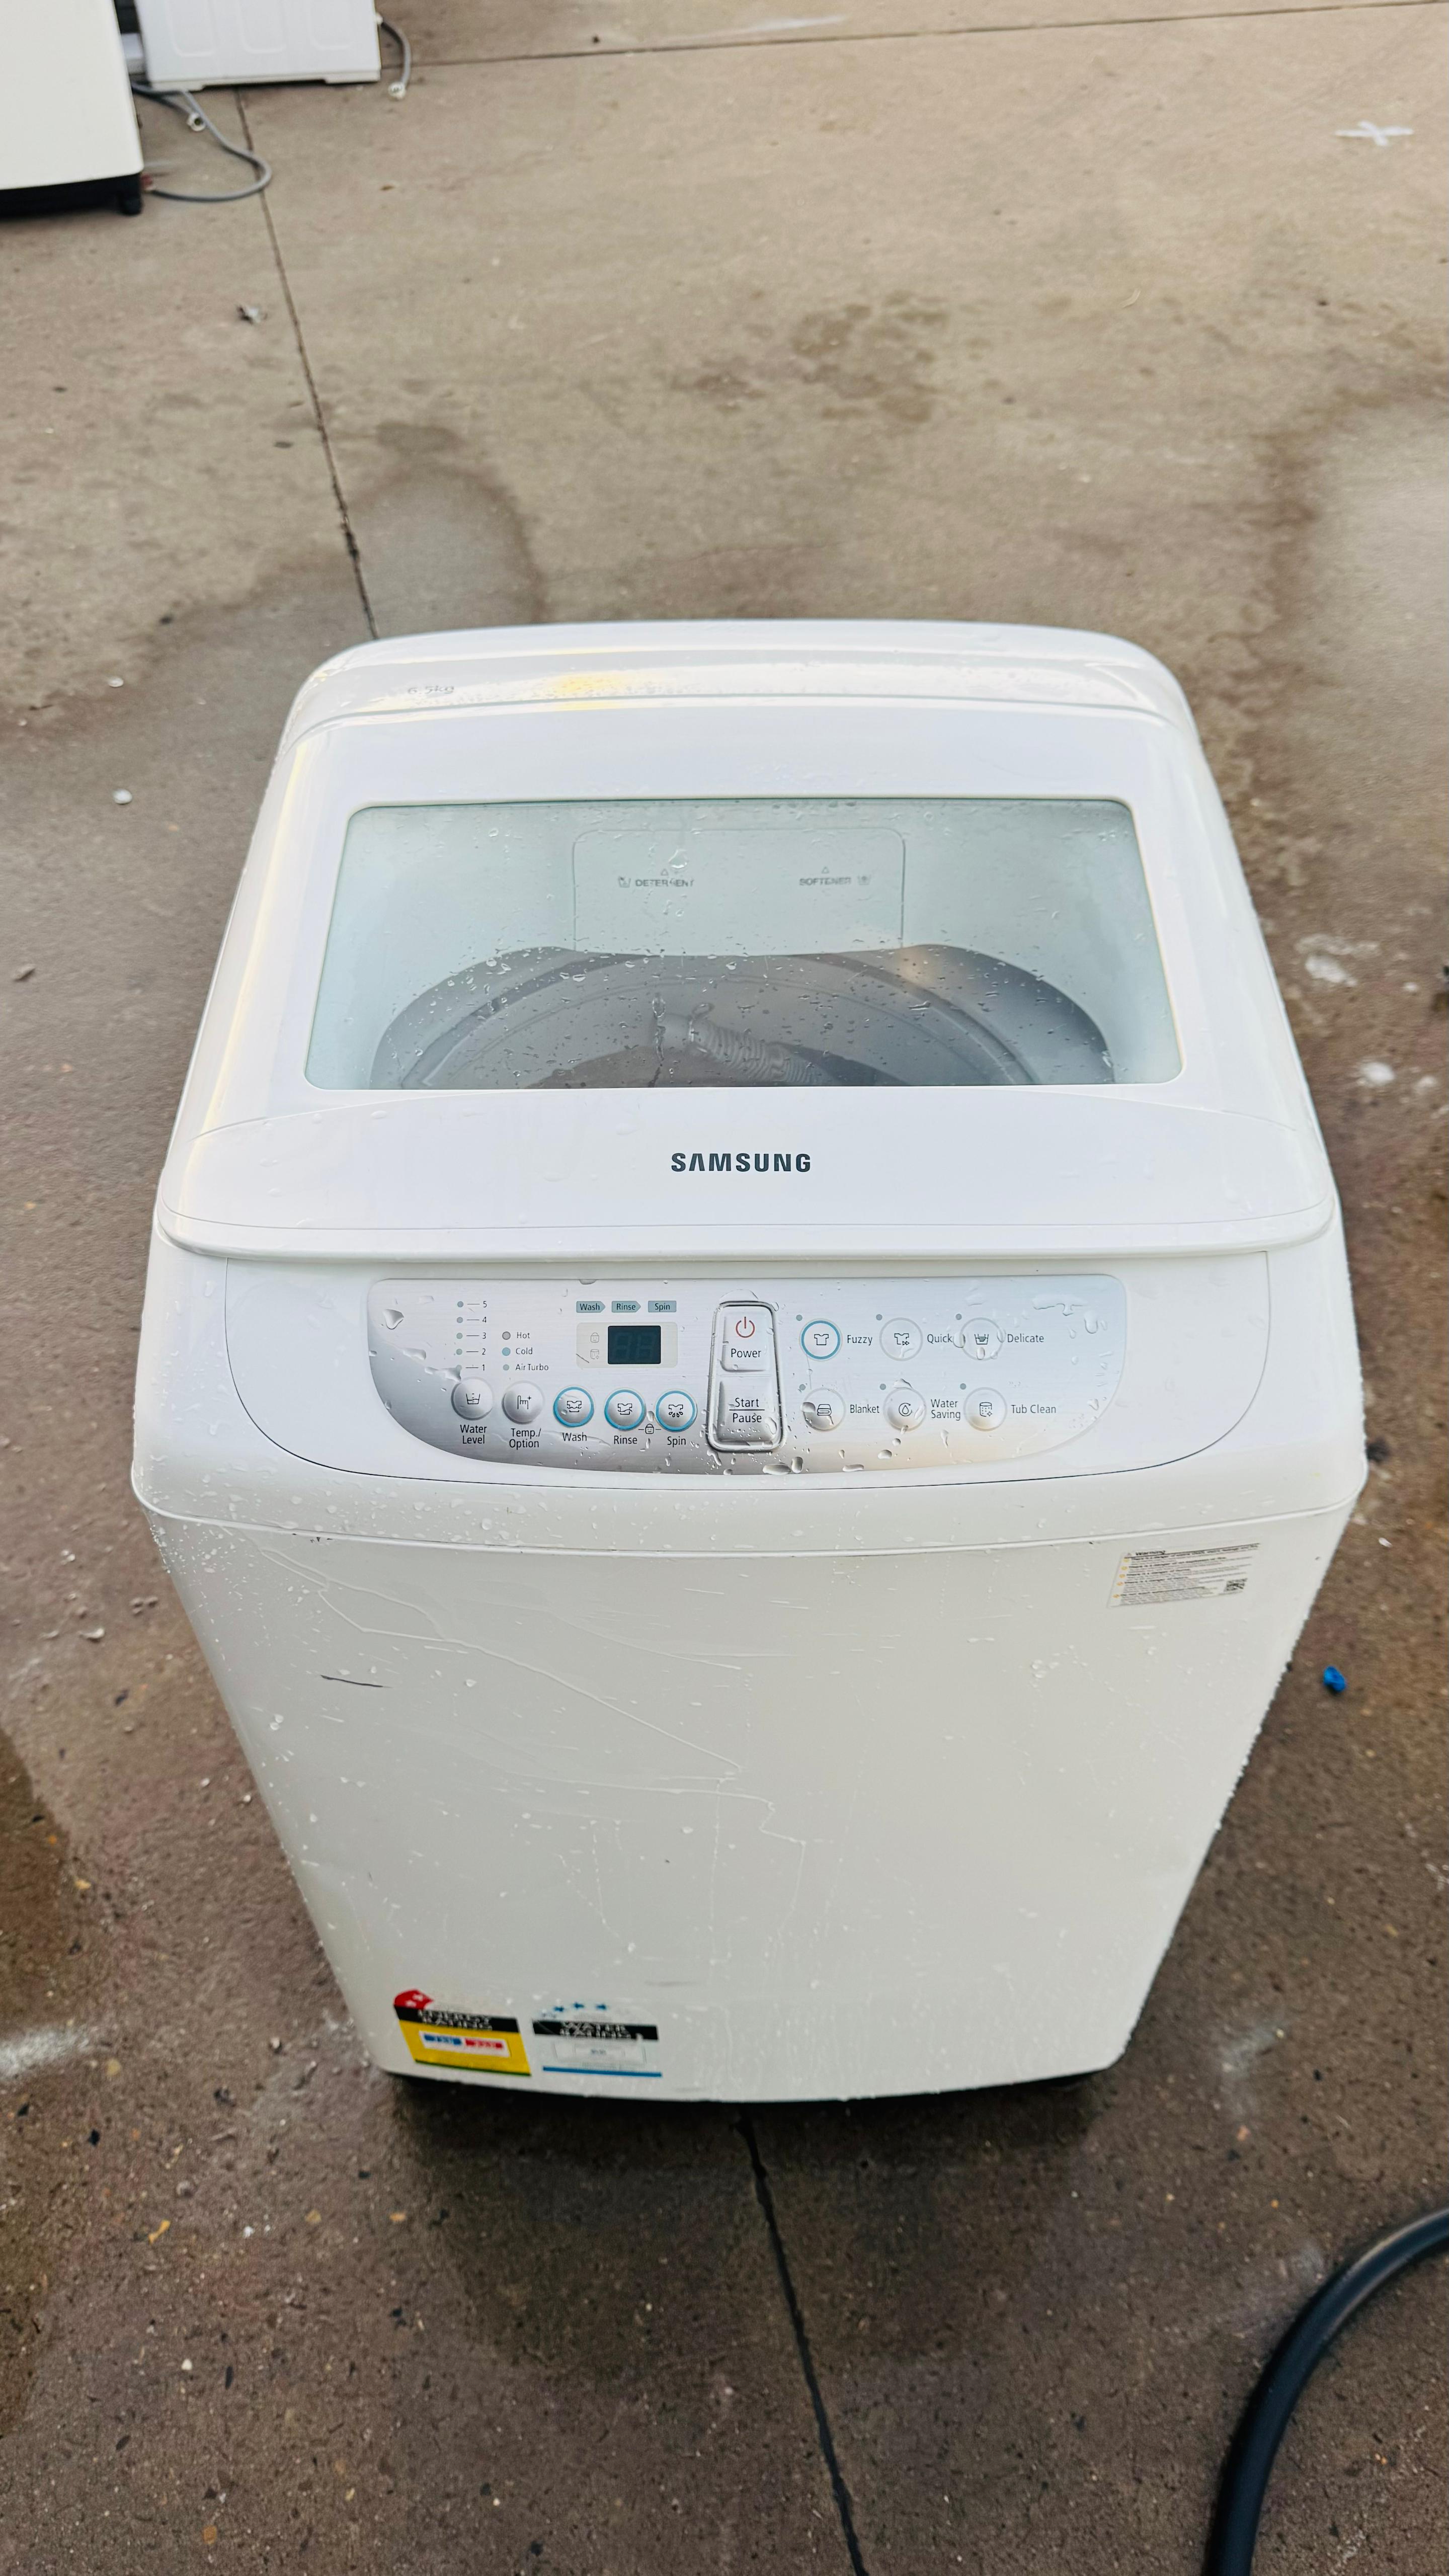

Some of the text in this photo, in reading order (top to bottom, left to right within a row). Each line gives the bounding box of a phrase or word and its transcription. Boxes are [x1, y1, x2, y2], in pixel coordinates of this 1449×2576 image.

[671, 1153, 811, 1172] SAMSUNG
[483, 1300, 488, 1308] 5
[580, 1303, 600, 1311] Wash
[655, 1303, 671, 1312] Spin
[516, 1331, 530, 1339] Hot
[847, 1334, 873, 1346] Fuzzy
[927, 1333, 953, 1343] Quick
[1007, 1333, 1044, 1343] Delicate
[515, 1347, 533, 1355] Cold
[731, 1348, 762, 1358] Power
[735, 1397, 759, 1407] Start
[930, 1399, 958, 1408] Water
[850, 1403, 880, 1414] Blanket
[1011, 1404, 1057, 1414] Tub Clean
[733, 1413, 762, 1423] Pause
[931, 1409, 961, 1421] Saving
[459, 1424, 488, 1434] Water
[510, 1427, 542, 1439] Temp./
[462, 1434, 485, 1444] Level
[562, 1432, 588, 1442] Wash
[613, 1434, 638, 1445] Rinse
[667, 1436, 687, 1448] Spin
[509, 1438, 539, 1451] Option
